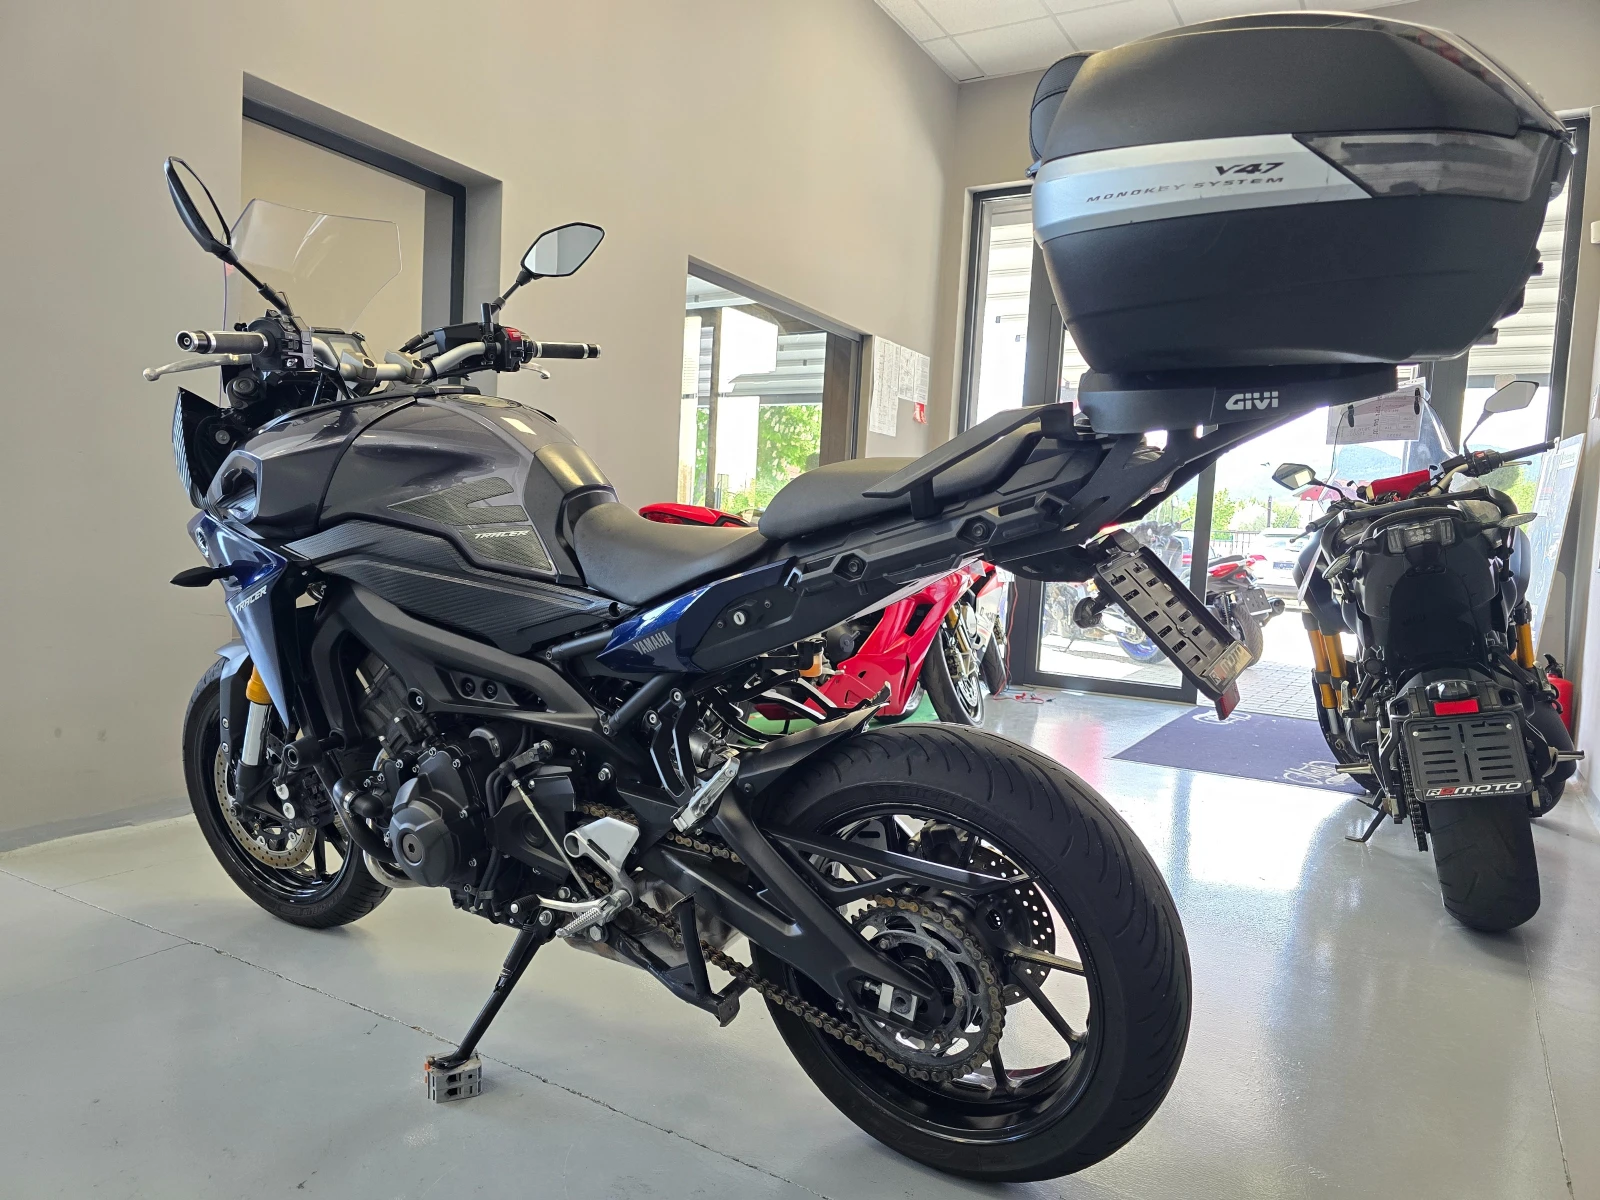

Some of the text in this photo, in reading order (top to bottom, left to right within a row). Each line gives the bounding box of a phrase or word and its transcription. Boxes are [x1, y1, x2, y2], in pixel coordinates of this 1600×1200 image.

[1215, 161, 1285, 176] V47
[1085, 177, 1285, 203] MONOKEY SYSTEM
[1225, 391, 1279, 410] GIVI
[474, 529, 531, 540] TRACER
[235, 584, 267, 614] TRACER
[632, 630, 673, 655] YAMAHA
